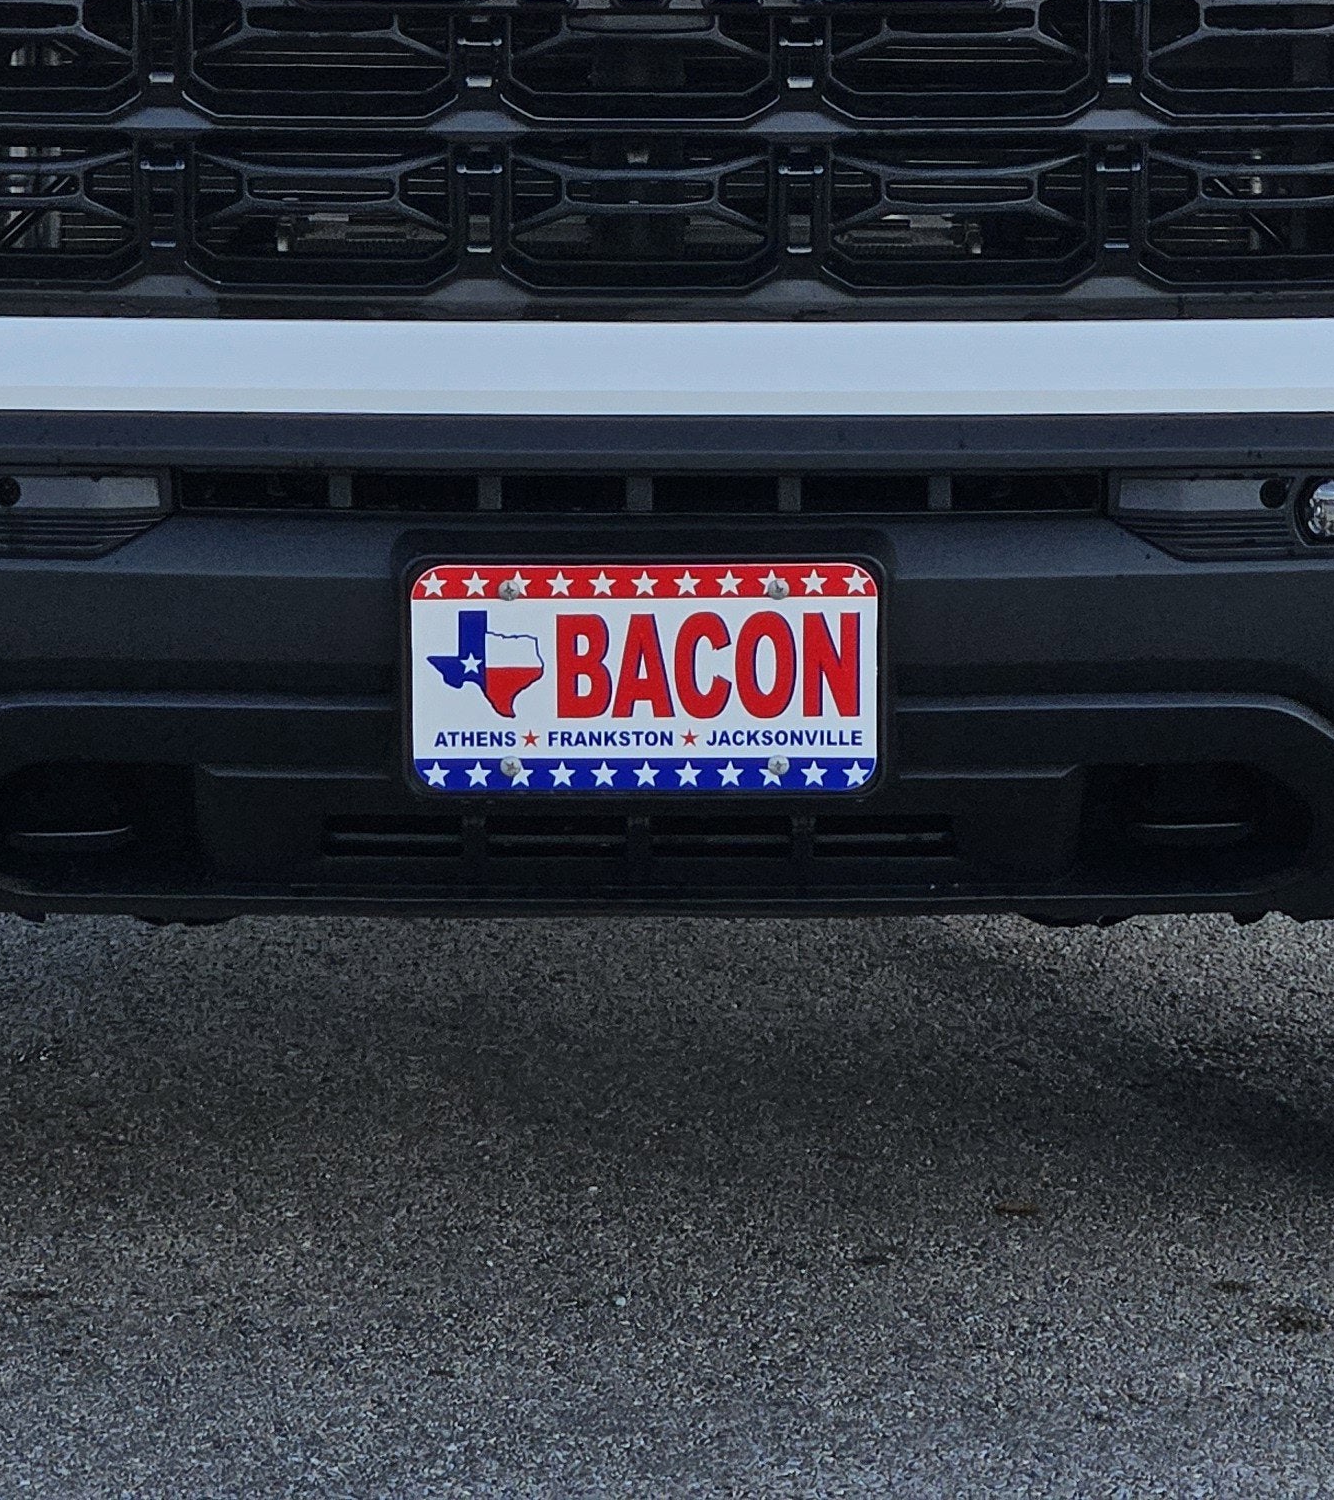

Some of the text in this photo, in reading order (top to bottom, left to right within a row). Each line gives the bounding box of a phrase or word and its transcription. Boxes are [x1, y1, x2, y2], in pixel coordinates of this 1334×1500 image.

[556, 611, 861, 719] BACON
[434, 729, 863, 747] ATHENS FRANKSTON JACKSONVILLE
